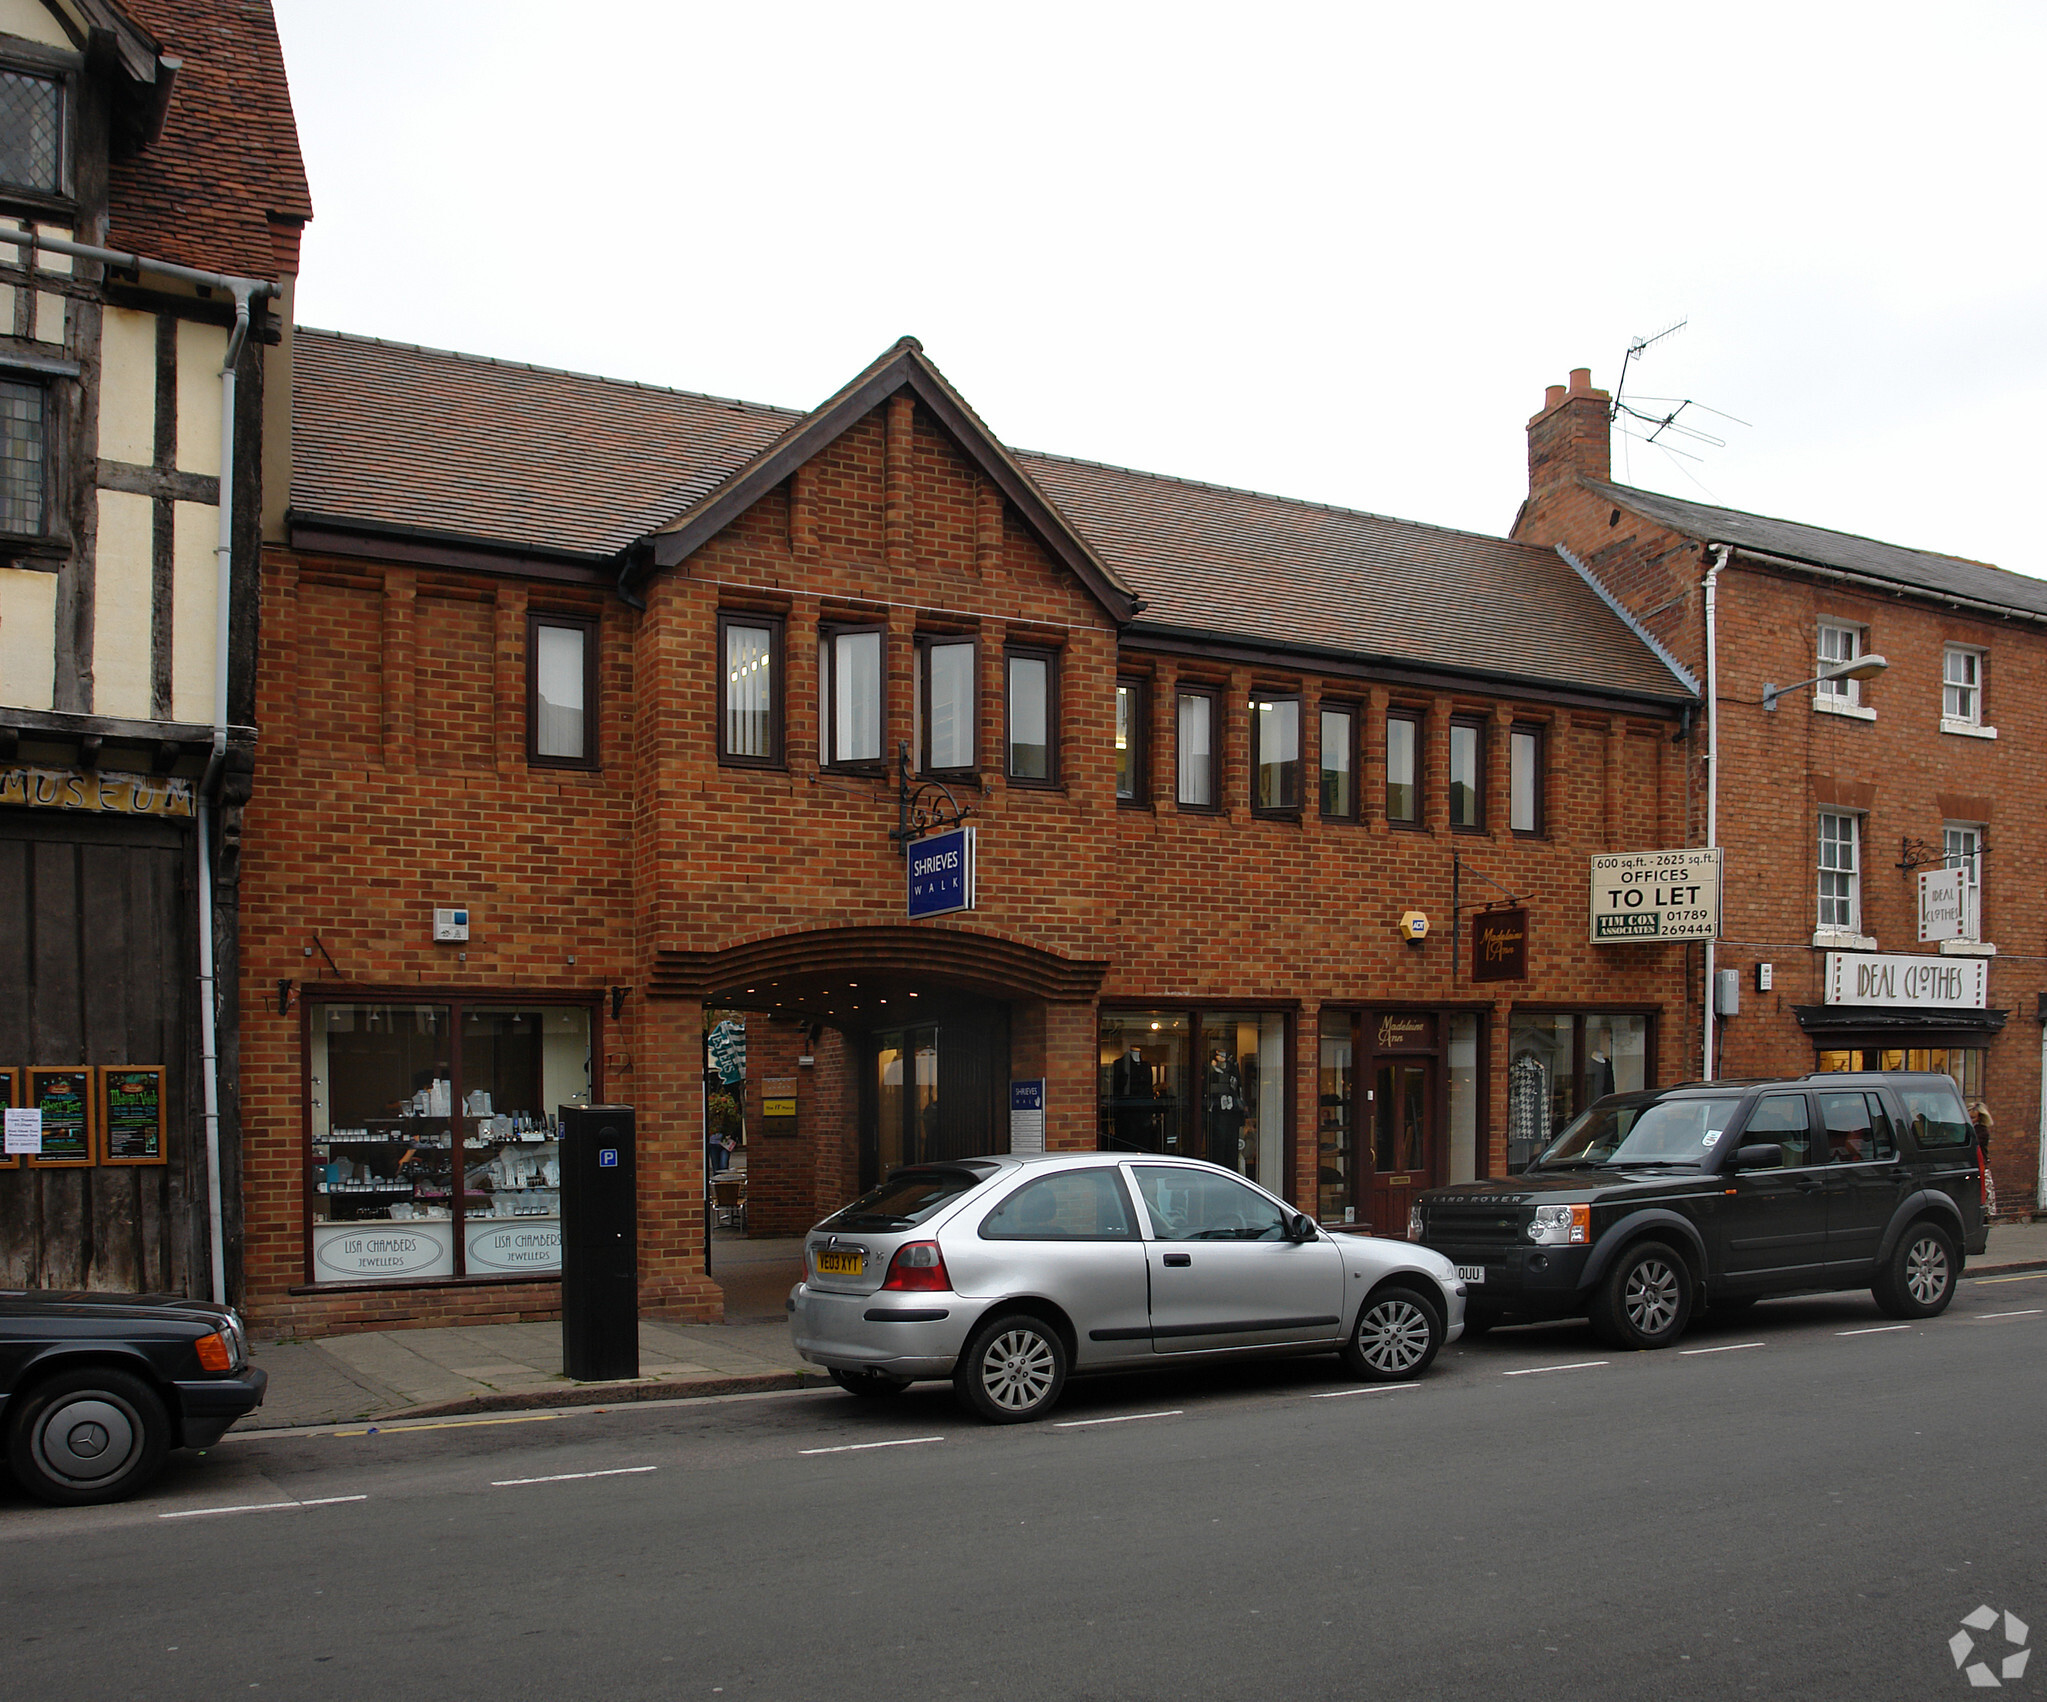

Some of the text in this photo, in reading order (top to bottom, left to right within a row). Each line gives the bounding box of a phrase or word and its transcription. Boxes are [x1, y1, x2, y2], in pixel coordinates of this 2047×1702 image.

[0, 769, 194, 816] MUSEUM
[914, 851, 958, 877] SHRIEVES
[1597, 859, 1618, 869] 600
[1621, 857, 1647, 869] sq.ft.
[1656, 855, 1685, 866] 2625
[1621, 869, 1688, 883] OFFICES
[914, 877, 958, 896] WALK
[1608, 886, 1700, 908] TO LET
[1932, 889, 1953, 902] IDEAL
[1600, 914, 1656, 927] TIM COX
[1667, 910, 1707, 921] 01789
[1926, 907, 1958, 922] CLOTHES
[1600, 925, 1655, 935] ASSOCIATES
[1661, 924, 1712, 935] 269444
[1857, 963, 1897, 998] IDEAL
[1904, 965, 1962, 1000] CLOTHES
[1380, 1015, 1424, 1031] Madeleine
[1378, 1029, 1404, 1047] Ann
[605, 1152, 613, 1164] P
[345, 1239, 417, 1253] LISA CHAMBERS
[495, 1233, 561, 1248] LISA CHAMBERS
[358, 1257, 404, 1267] JEWELLERS
[508, 1251, 549, 1261] JEWELLERS
